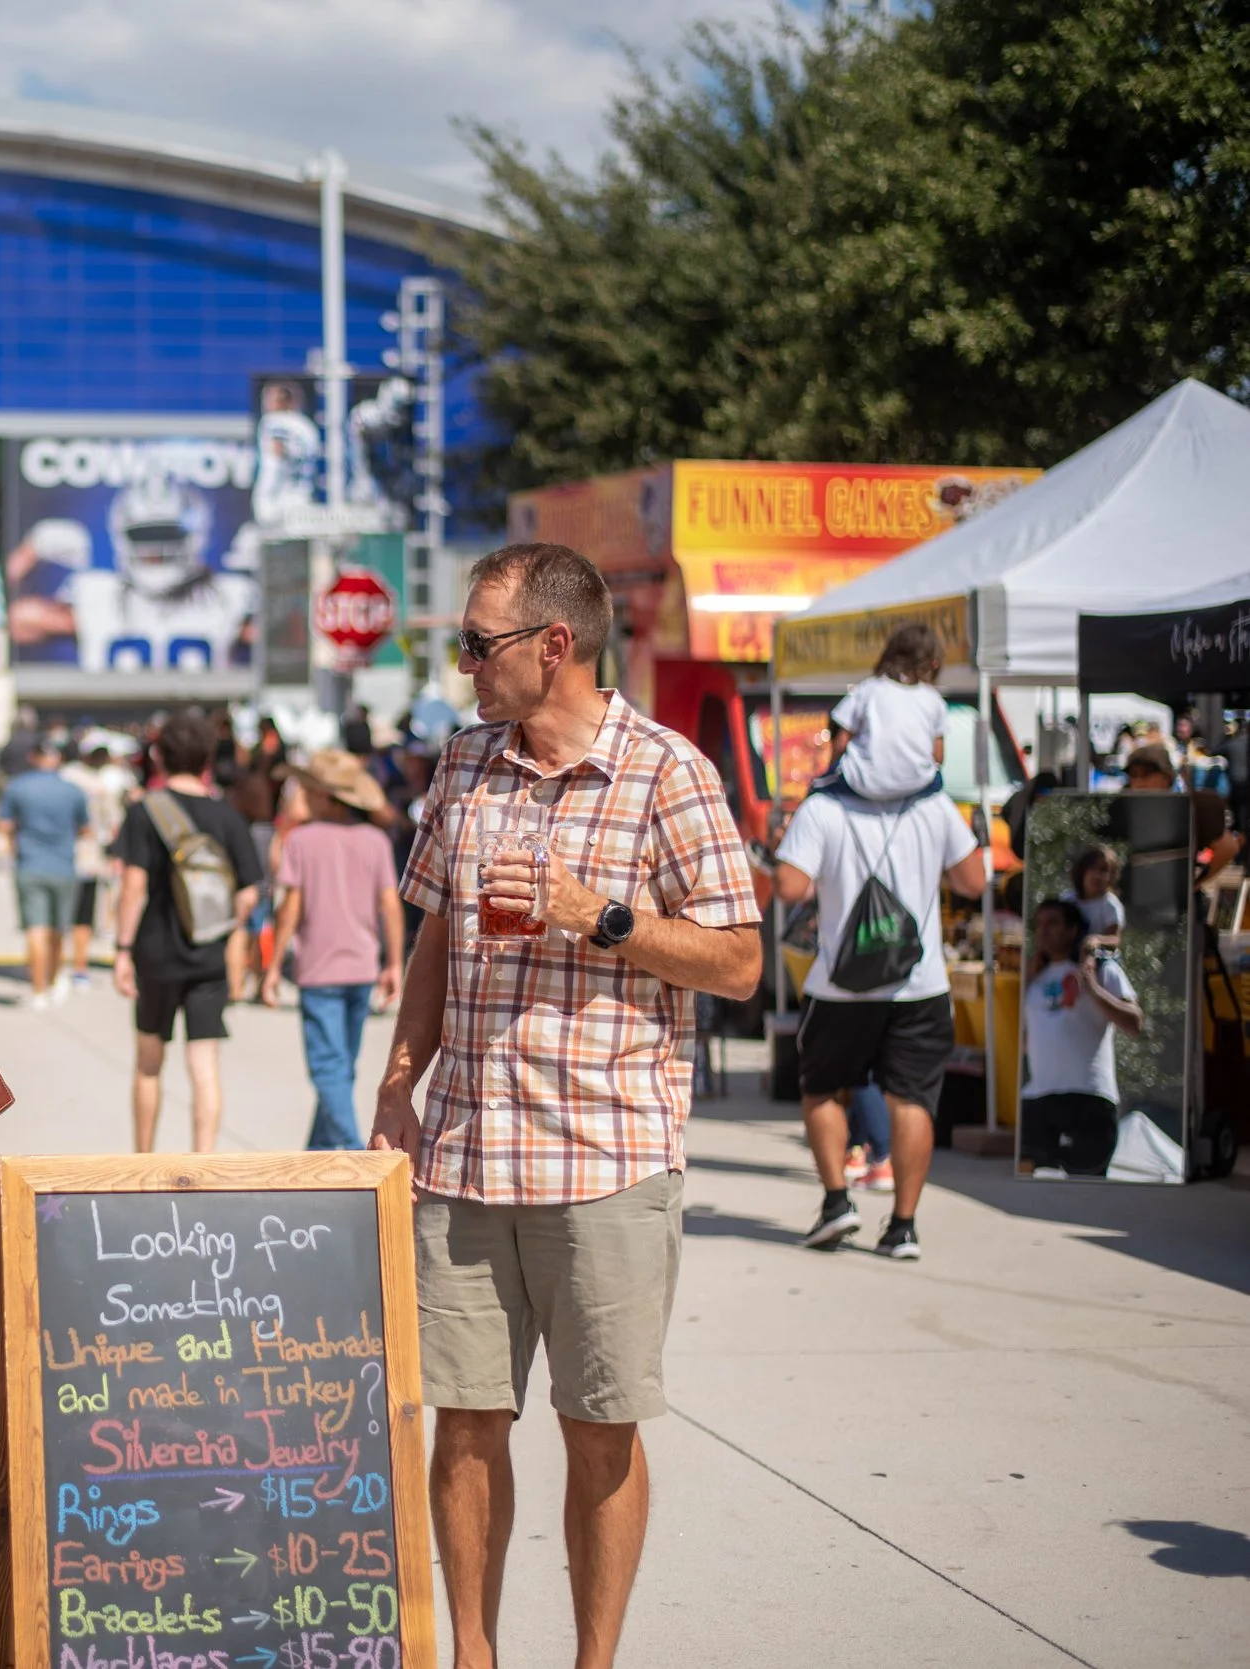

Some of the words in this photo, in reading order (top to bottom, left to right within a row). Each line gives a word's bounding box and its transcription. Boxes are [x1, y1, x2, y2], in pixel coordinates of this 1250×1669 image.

[686, 476, 821, 537] FUNNEL
[825, 476, 939, 539] CAKES
[317, 591, 394, 634] STOP
[92, 1199, 236, 1279] Looking
[254, 1215, 332, 1272] for
[100, 1278, 284, 1339] Something
[44, 1326, 164, 1378] Unique
[176, 1319, 232, 1362] and
[251, 1310, 383, 1363] Handmade
[57, 1372, 109, 1414] and
[128, 1371, 205, 1410] made
[214, 1375, 239, 1405] in
[244, 1409, 361, 1499] Jewelry
[57, 1483, 161, 1546] Rings
[52, 1540, 187, 1592] Earrings
[59, 1587, 223, 1638] Bracelets
